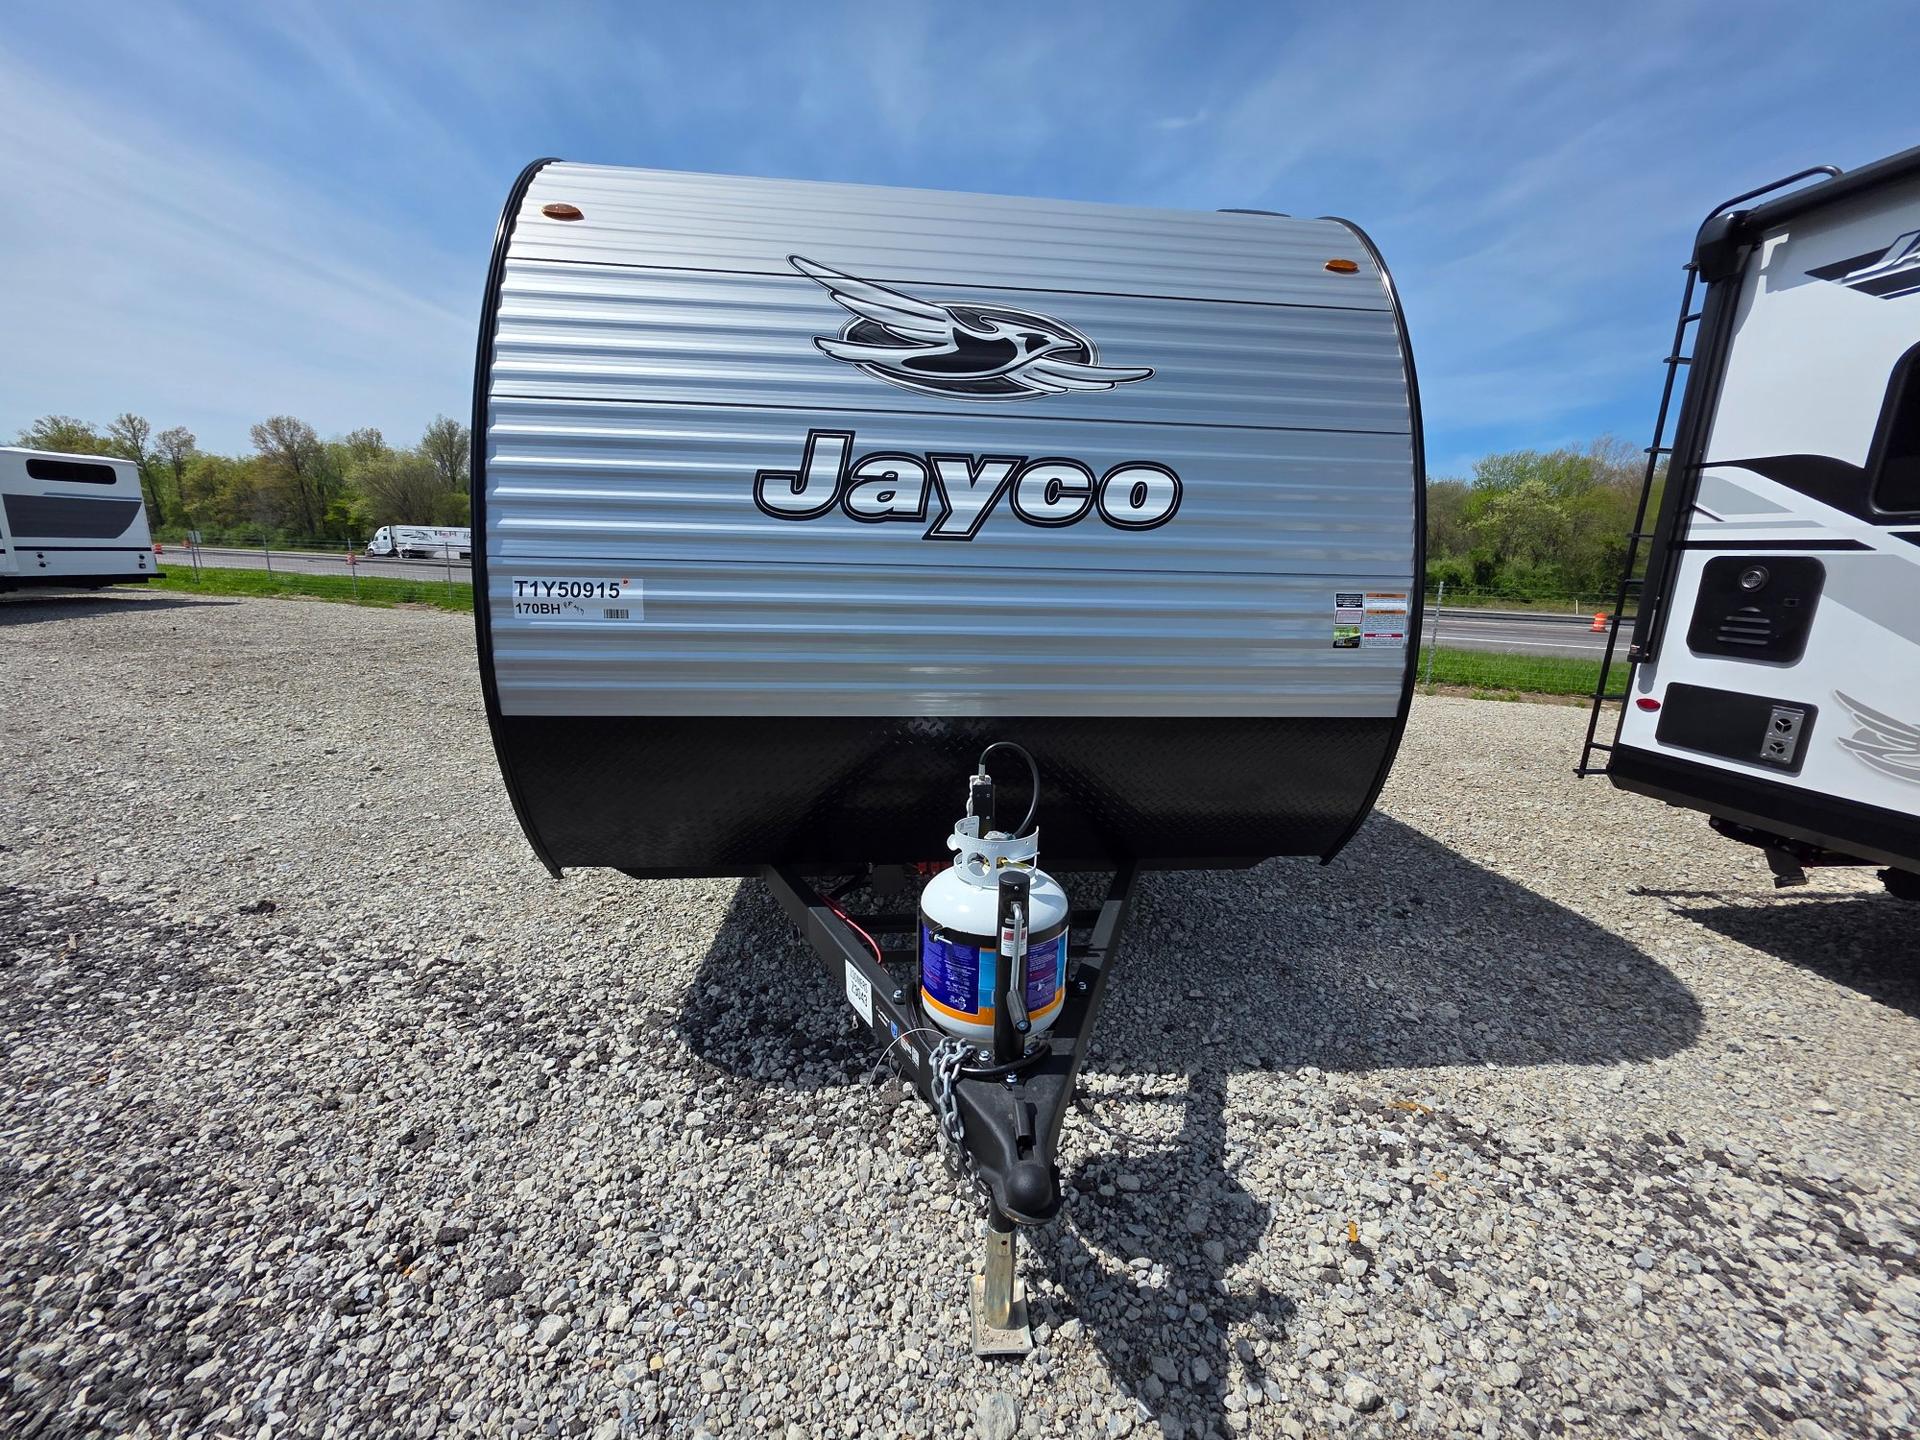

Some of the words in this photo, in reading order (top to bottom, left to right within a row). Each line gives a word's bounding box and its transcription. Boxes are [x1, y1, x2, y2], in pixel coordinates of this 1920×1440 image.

[753, 428, 1184, 541] Jayco
[514, 580, 620, 599] T1Y50915
[515, 603, 561, 615] 170BH
